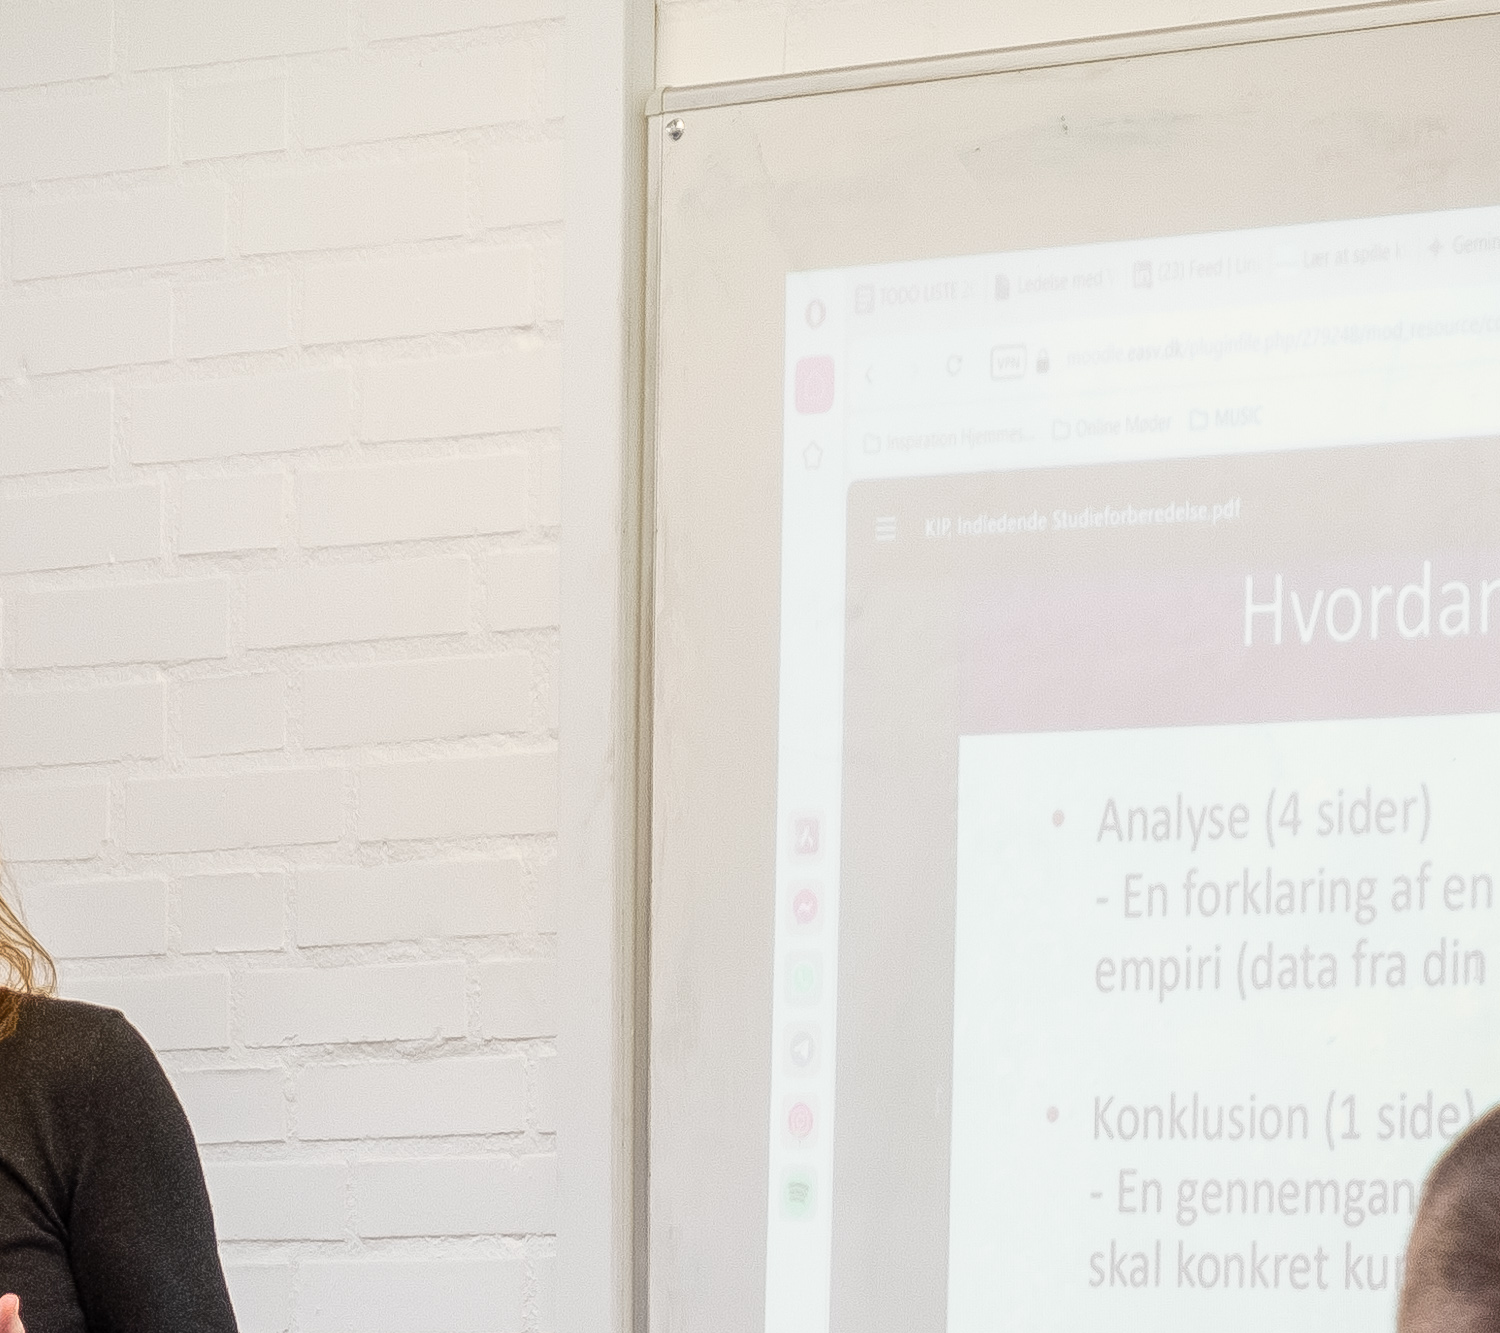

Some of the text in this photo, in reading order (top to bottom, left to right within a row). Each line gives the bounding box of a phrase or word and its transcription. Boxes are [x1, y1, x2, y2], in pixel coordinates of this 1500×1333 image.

[957, 512, 1048, 536] Indledende
[1052, 495, 1242, 532] Studieforberedelse.pdf
[1096, 783, 1432, 851] Analyse (4 sider)
[1123, 871, 1169, 920] En
[1183, 867, 1378, 925] forklaring
[1391, 863, 1434, 913] af
[1443, 871, 1493, 911] en
[1096, 944, 1221, 1003] empiri
[1236, 939, 1337, 1000] (data
[1351, 938, 1406, 989] fra
[1423, 936, 1486, 987] din
[1091, 1093, 1310, 1143] Konklusion
[1324, 1089, 1362, 1151] (1
[1116, 1170, 1162, 1214] En
[1175, 1175, 1418, 1228] gennemgan
[1088, 1240, 1162, 1289] skal
[1175, 1241, 1329, 1290] konkret
